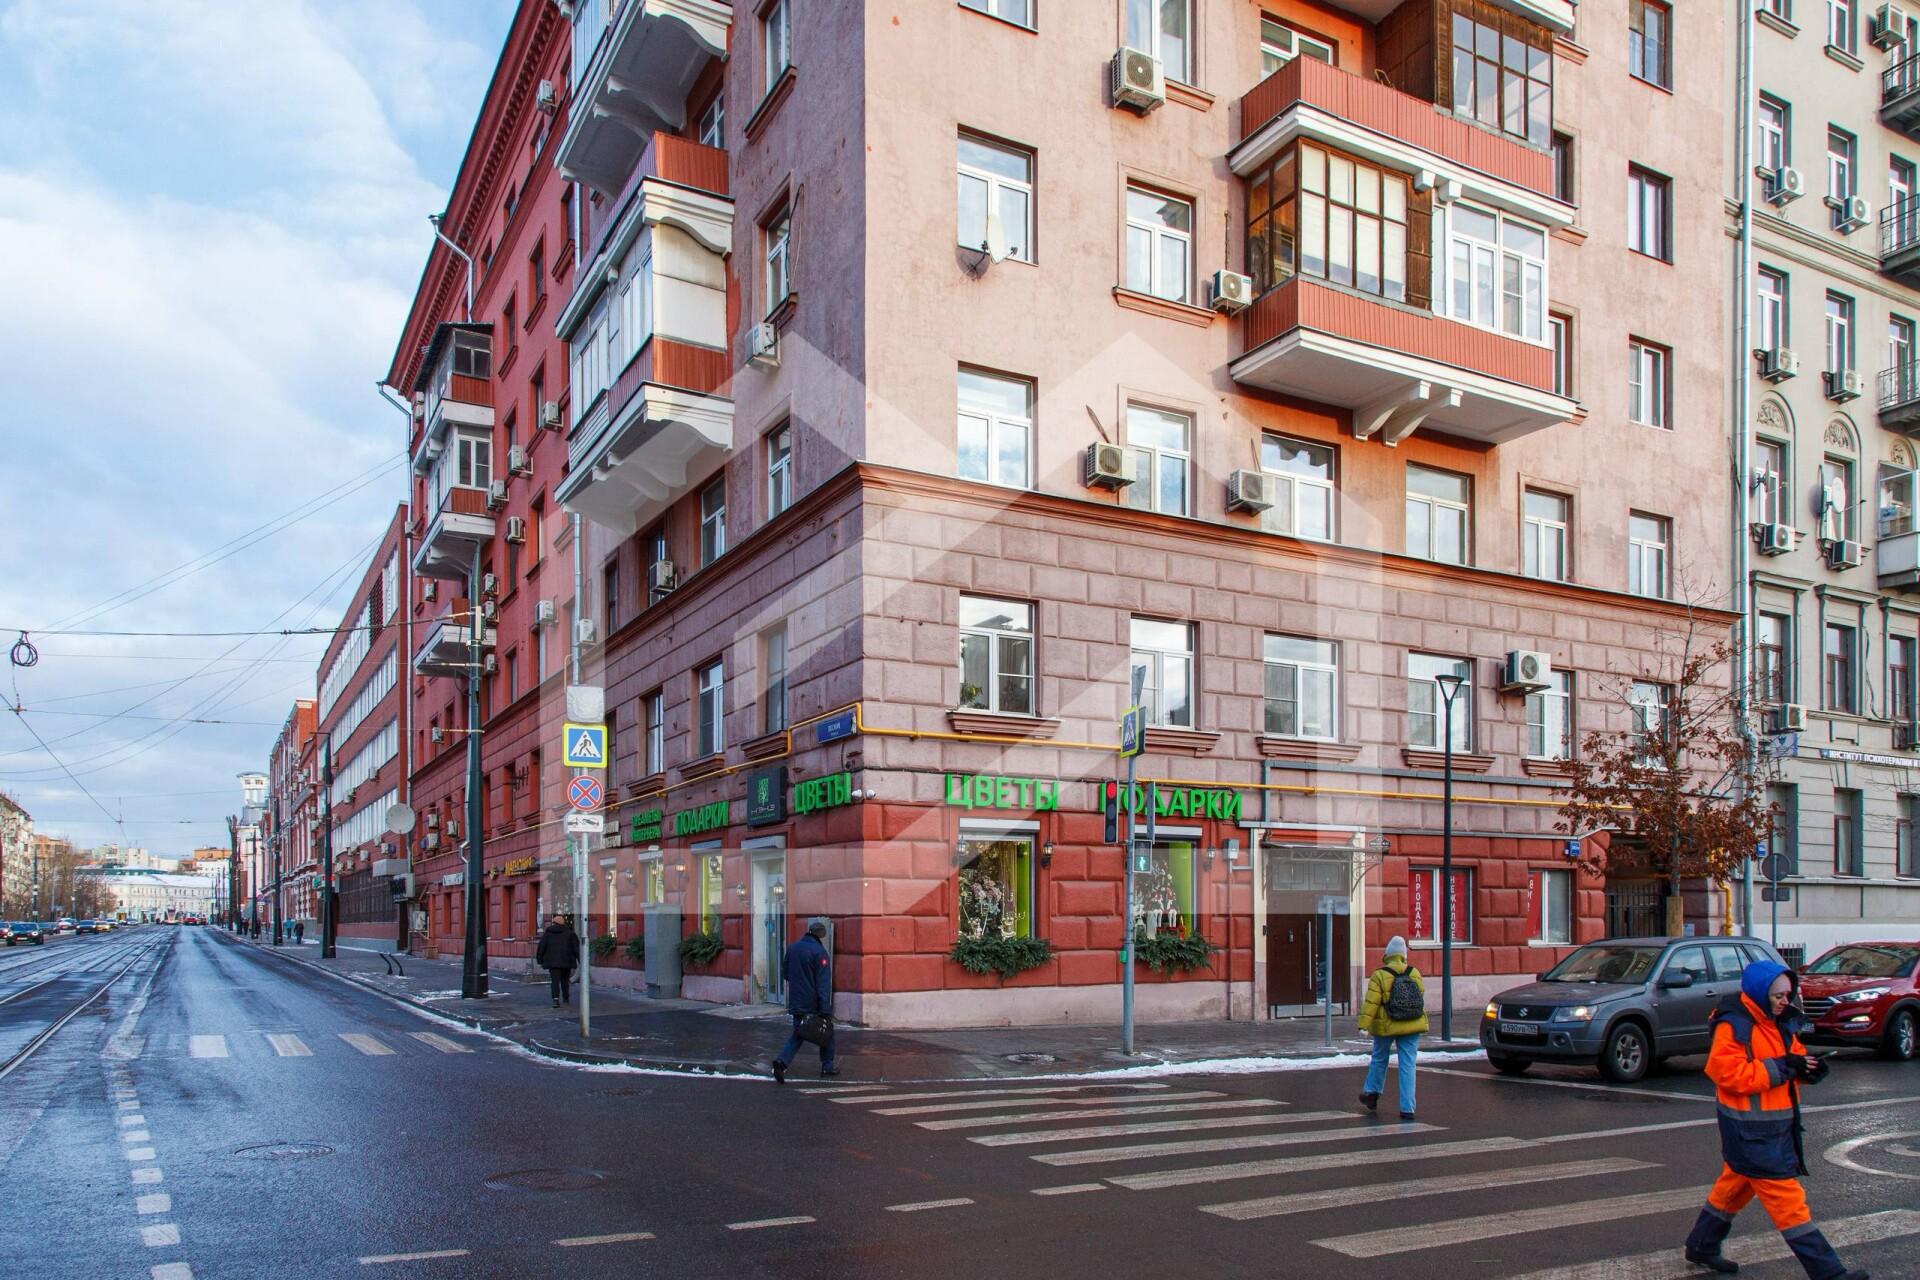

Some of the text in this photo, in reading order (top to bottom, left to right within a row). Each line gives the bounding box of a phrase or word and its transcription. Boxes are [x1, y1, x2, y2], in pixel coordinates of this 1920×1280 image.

[1829, 751, 1862, 761] ИНСТИТУТ
[794, 772, 852, 815] ЦВЕТЫ
[945, 774, 1058, 811] ЦВЕТЫ
[1099, 783, 1242, 820] ОДАРКИ
[676, 801, 729, 836] ПОДАРКИ
